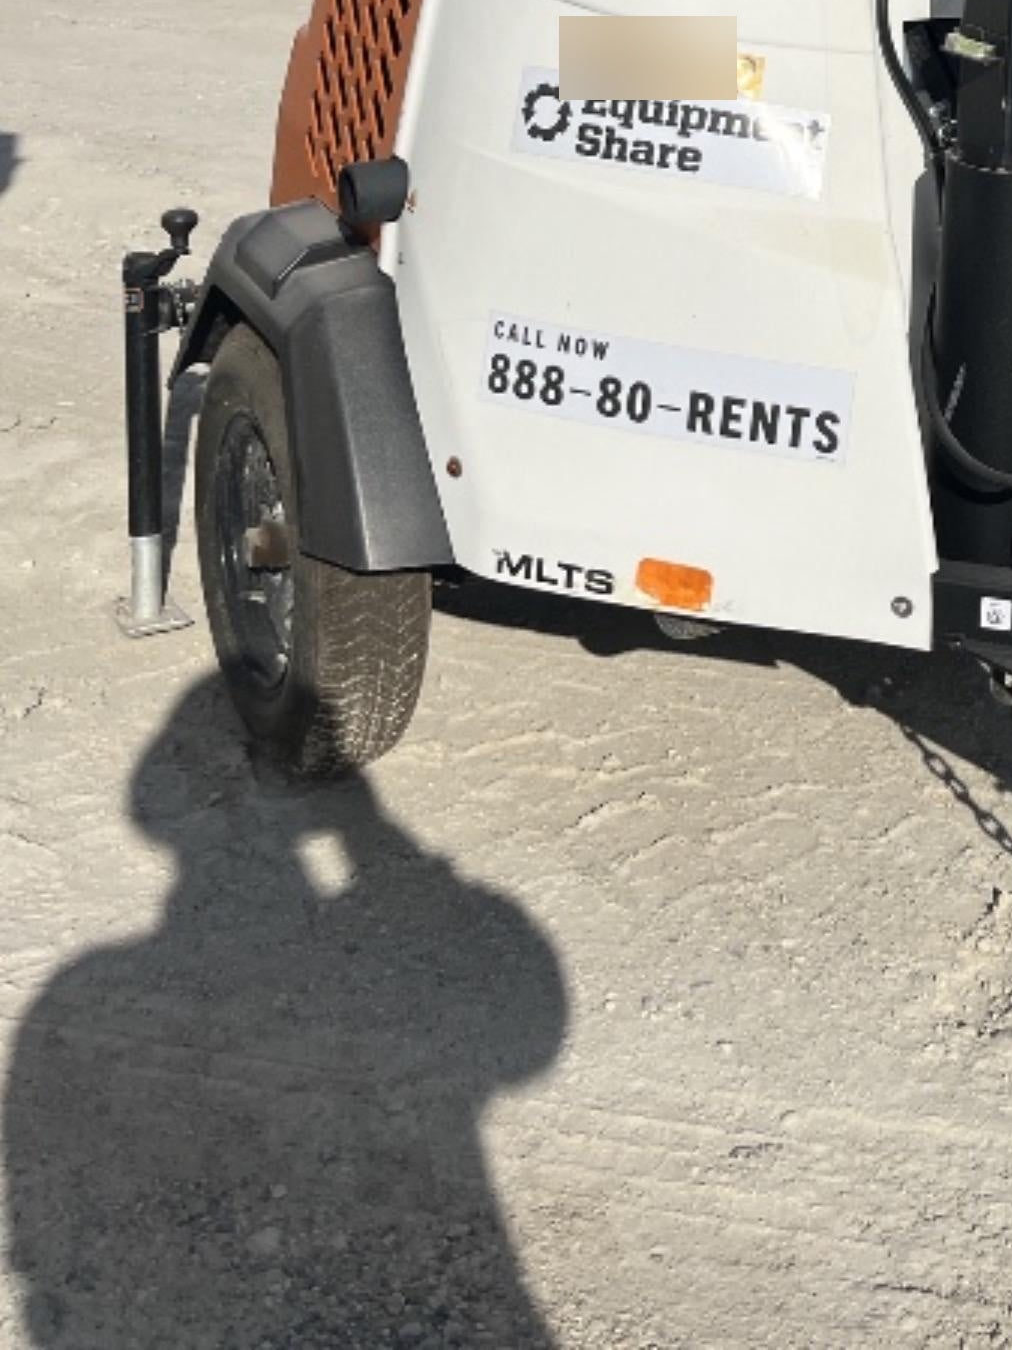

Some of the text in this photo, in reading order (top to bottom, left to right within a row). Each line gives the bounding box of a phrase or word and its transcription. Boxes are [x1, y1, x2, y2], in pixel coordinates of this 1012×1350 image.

[574, 122, 703, 173] Share
[581, 99, 826, 150] Equipmt
[493, 319, 610, 361] CALL NOW
[487, 352, 842, 455] 888-80-RENTS
[496, 551, 615, 595] MLTS
